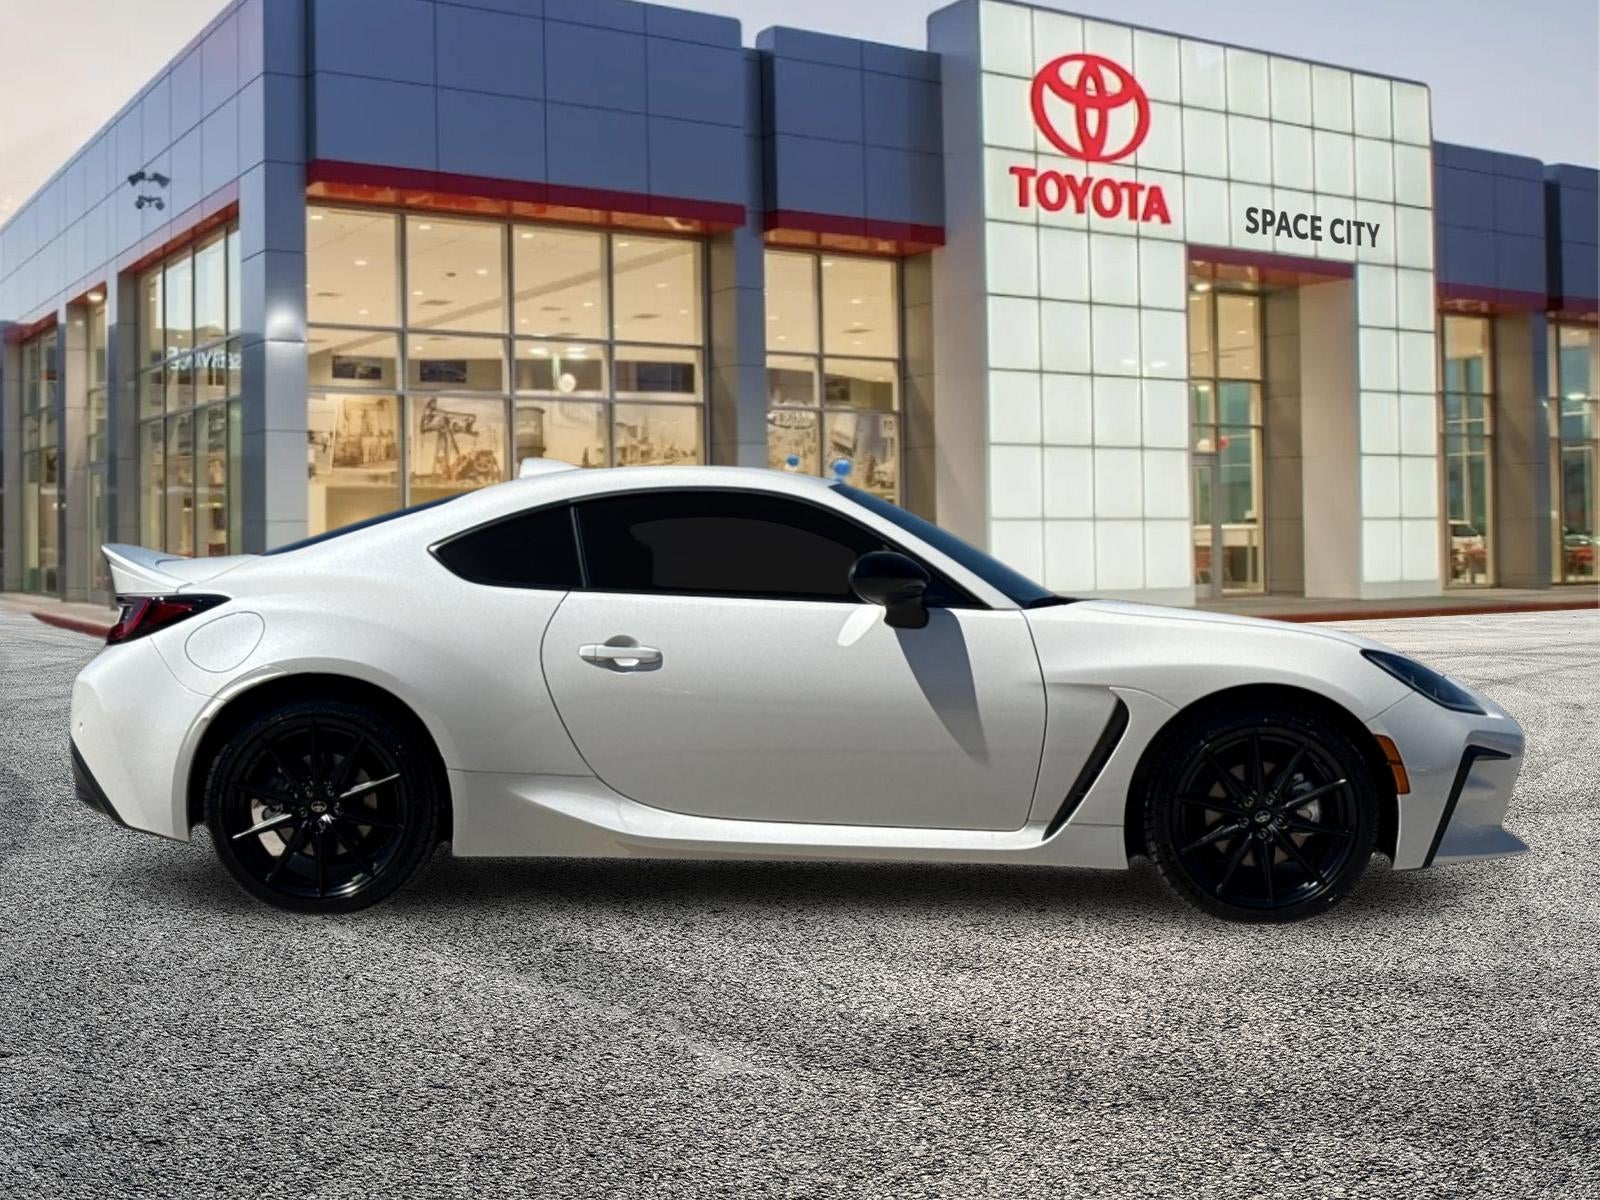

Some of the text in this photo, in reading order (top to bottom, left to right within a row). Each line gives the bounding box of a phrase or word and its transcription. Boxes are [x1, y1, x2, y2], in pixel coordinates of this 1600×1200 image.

[1009, 166, 1171, 225] TOYOTA
[1245, 206, 1381, 248] SPACE CITY
